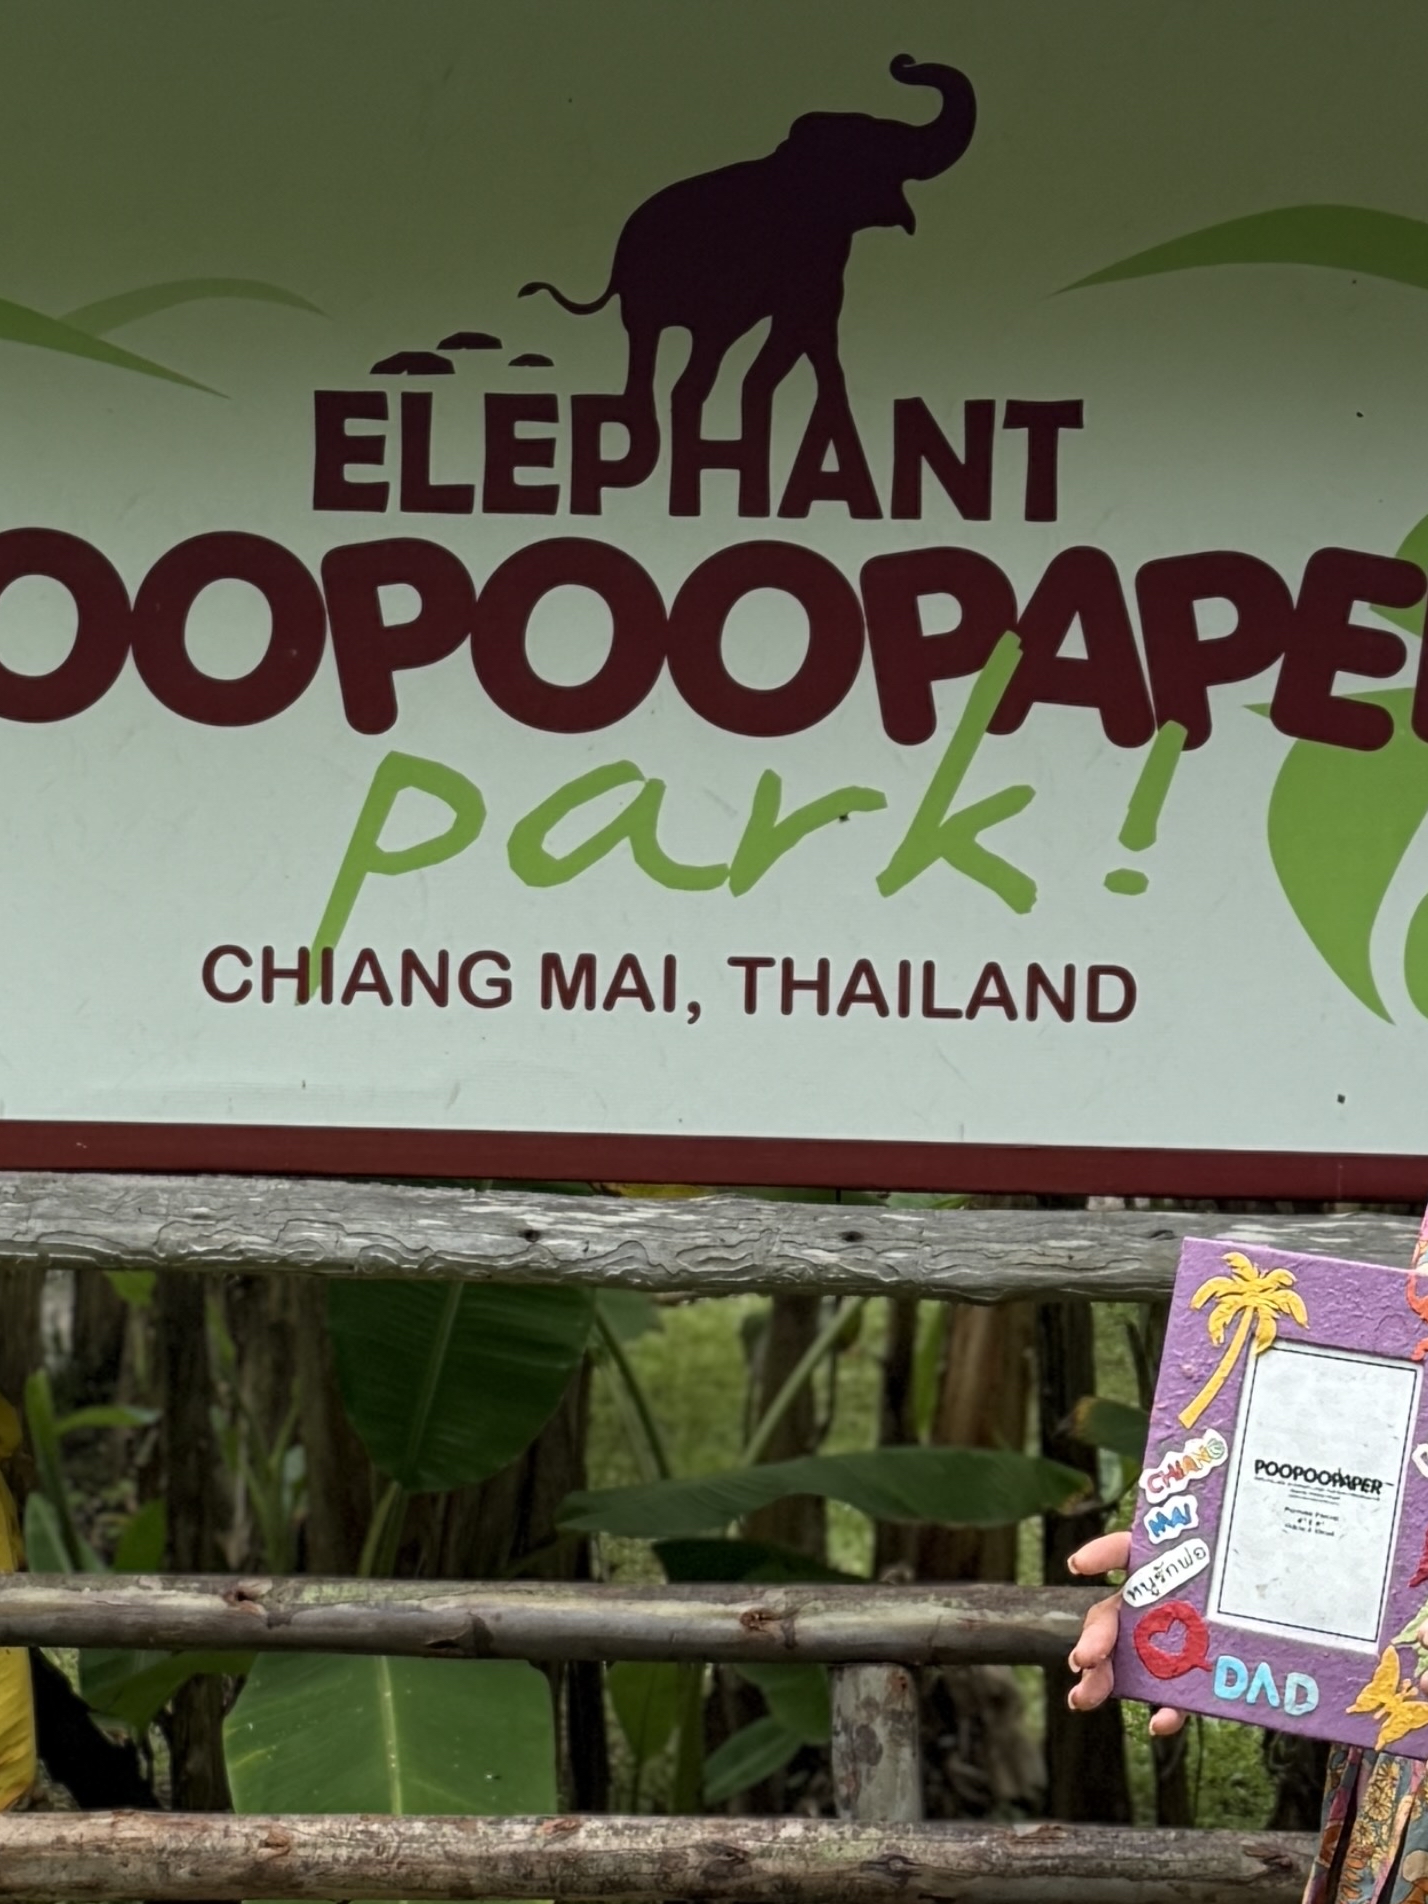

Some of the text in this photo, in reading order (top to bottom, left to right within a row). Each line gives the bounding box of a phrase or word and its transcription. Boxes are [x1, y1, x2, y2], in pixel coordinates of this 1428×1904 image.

[313, 390, 1084, 522] ELEPHANT
[292, 628, 1189, 1007] park!
[201, 944, 1138, 1024] CHIANG MAI, THAILAND
[1147, 1502, 1193, 1538] MAI
[1213, 1654, 1320, 1717] DAD
